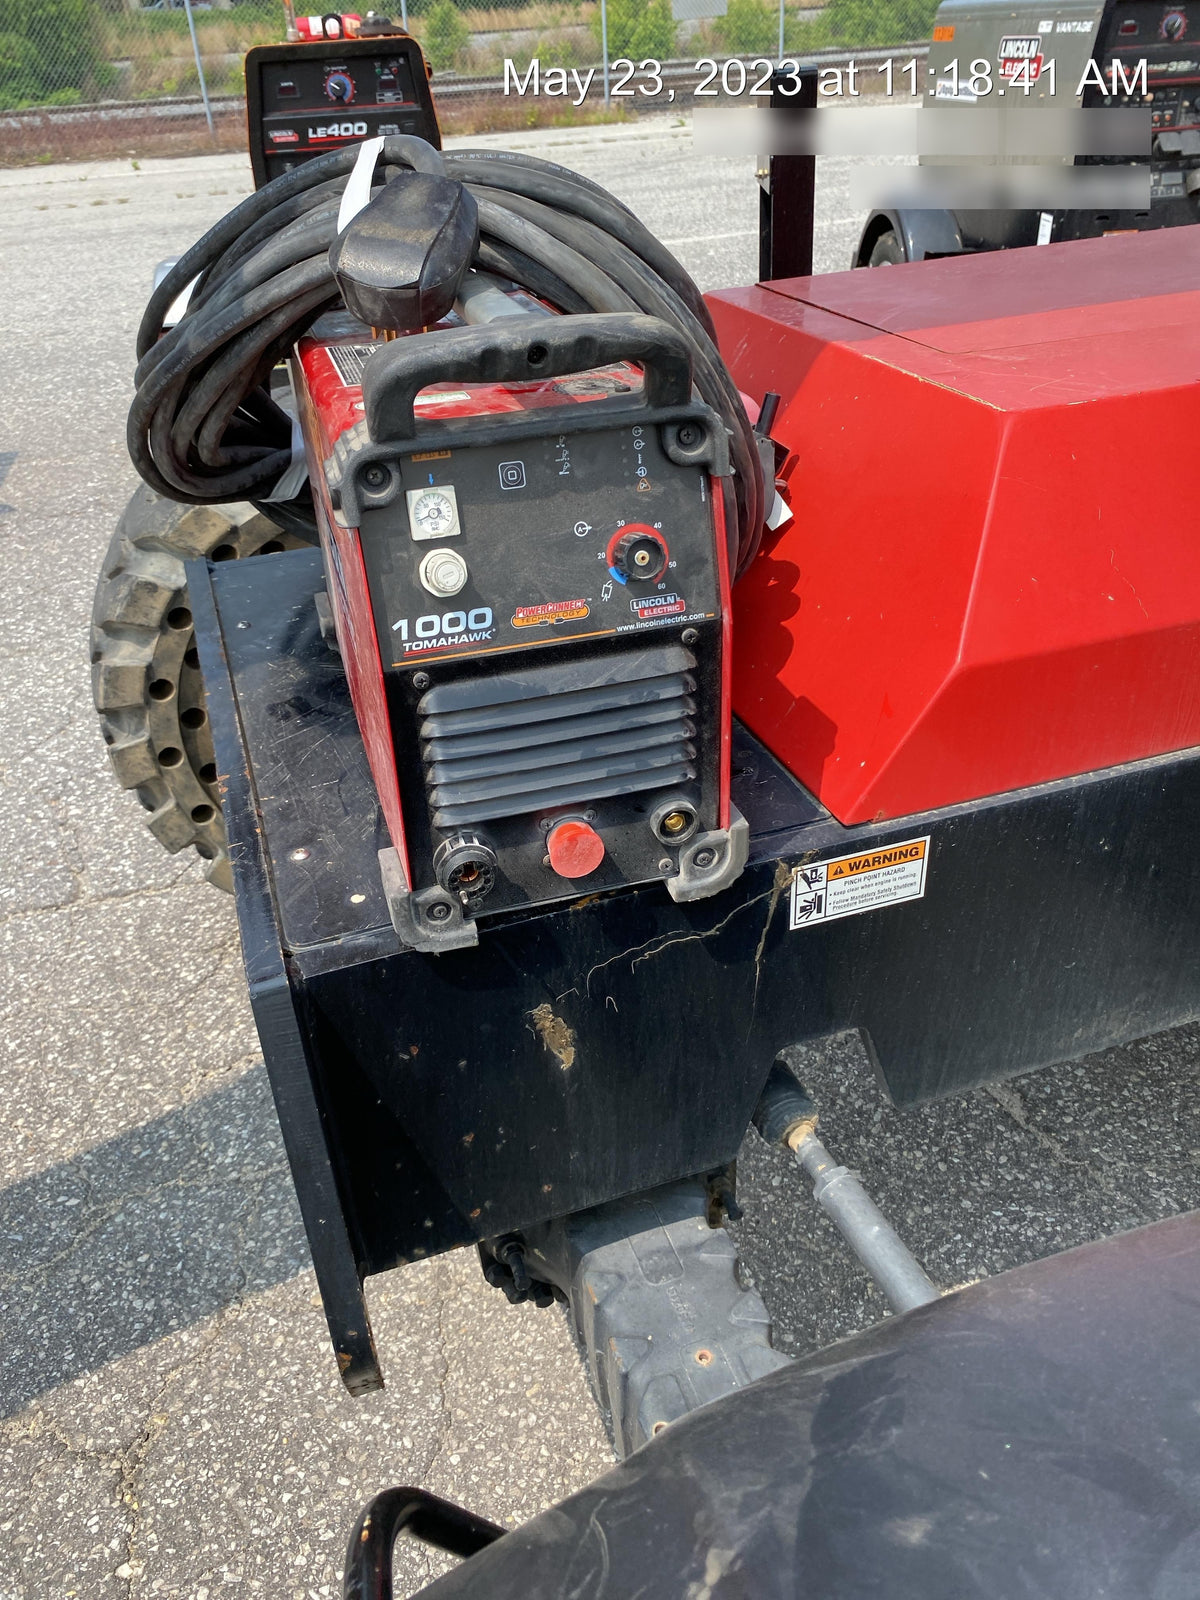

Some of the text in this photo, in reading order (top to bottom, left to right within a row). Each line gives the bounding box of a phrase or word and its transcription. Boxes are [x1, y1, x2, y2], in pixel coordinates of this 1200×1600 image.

[1001, 40, 1039, 59] LINCOLN
[308, 122, 367, 138] LE400
[633, 595, 675, 610] LINCOLN
[644, 604, 681, 616] ELECTRIC
[392, 607, 493, 641] 1000
[521, 609, 582, 624] TECHNOLOGY
[616, 613, 705, 632] www.lincolnelectric.com
[403, 630, 493, 652] TOMAHAWK
[848, 847, 920, 872] WARNING
[844, 866, 906, 886] PINCH POINT HAZARD
[875, 879, 891, 887] engine
[850, 891, 876, 901] Mandatory
[893, 881, 917, 890] Shutdown
